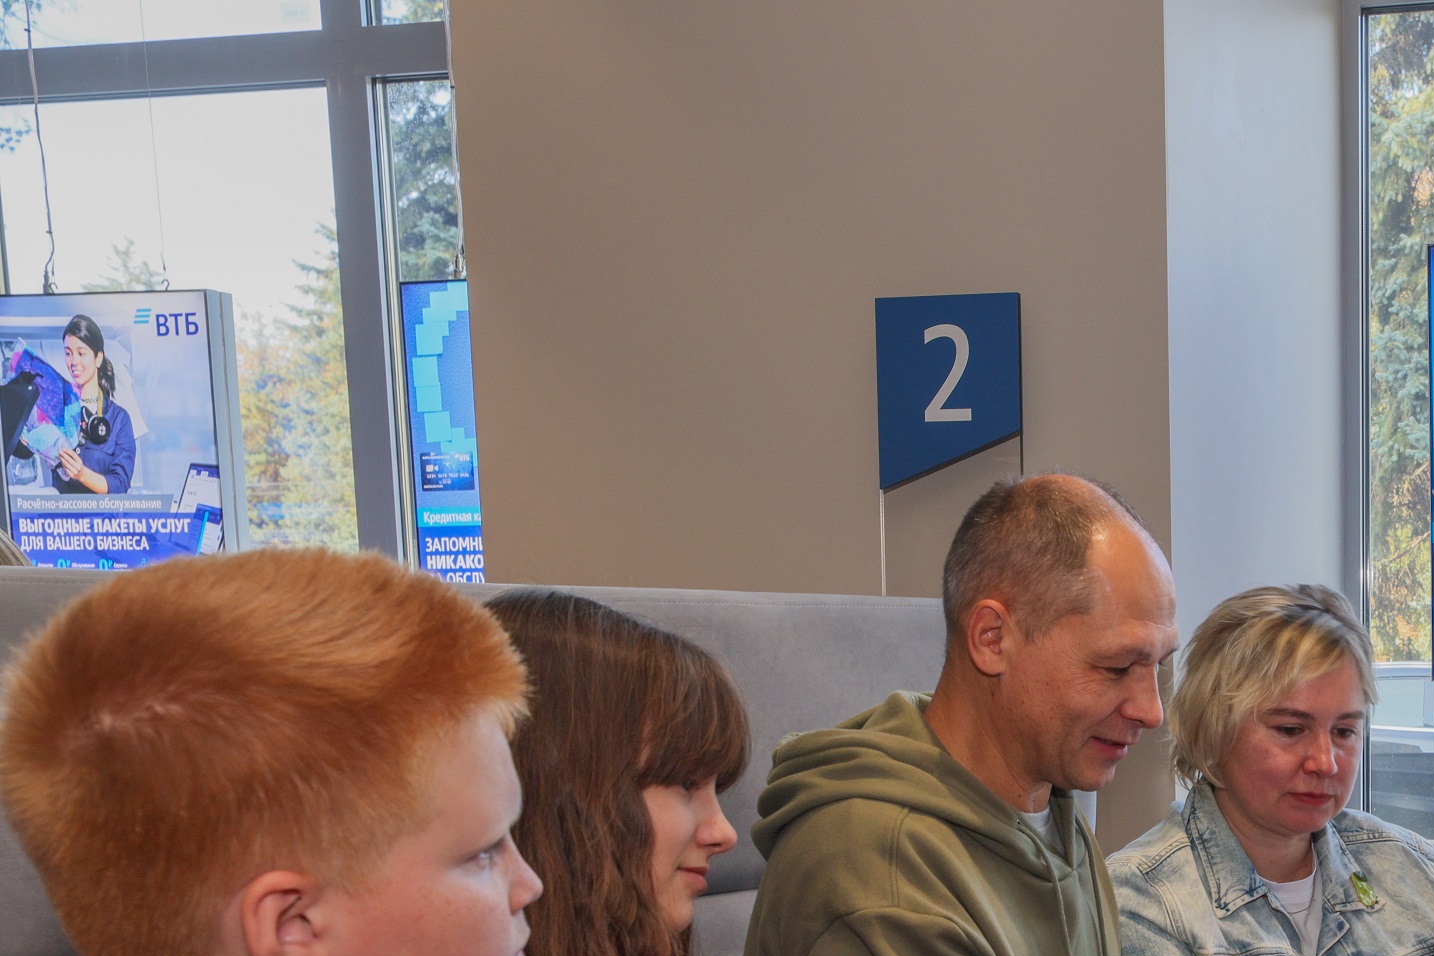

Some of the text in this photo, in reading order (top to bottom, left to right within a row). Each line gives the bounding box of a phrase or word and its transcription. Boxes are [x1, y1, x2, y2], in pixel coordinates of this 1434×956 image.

[155, 312, 199, 337] ВТБ
[923, 323, 972, 423] 2
[17, 497, 162, 511] Расчётно-кассовое обслуживание
[18, 518, 191, 535] ВЫГОДНЫЕ ПАКЕТЫ УСЛУГ
[423, 511, 472, 525] Кредитная
[20, 535, 149, 552] ДЛЯ ВАШЕГО БИЗНЕСА
